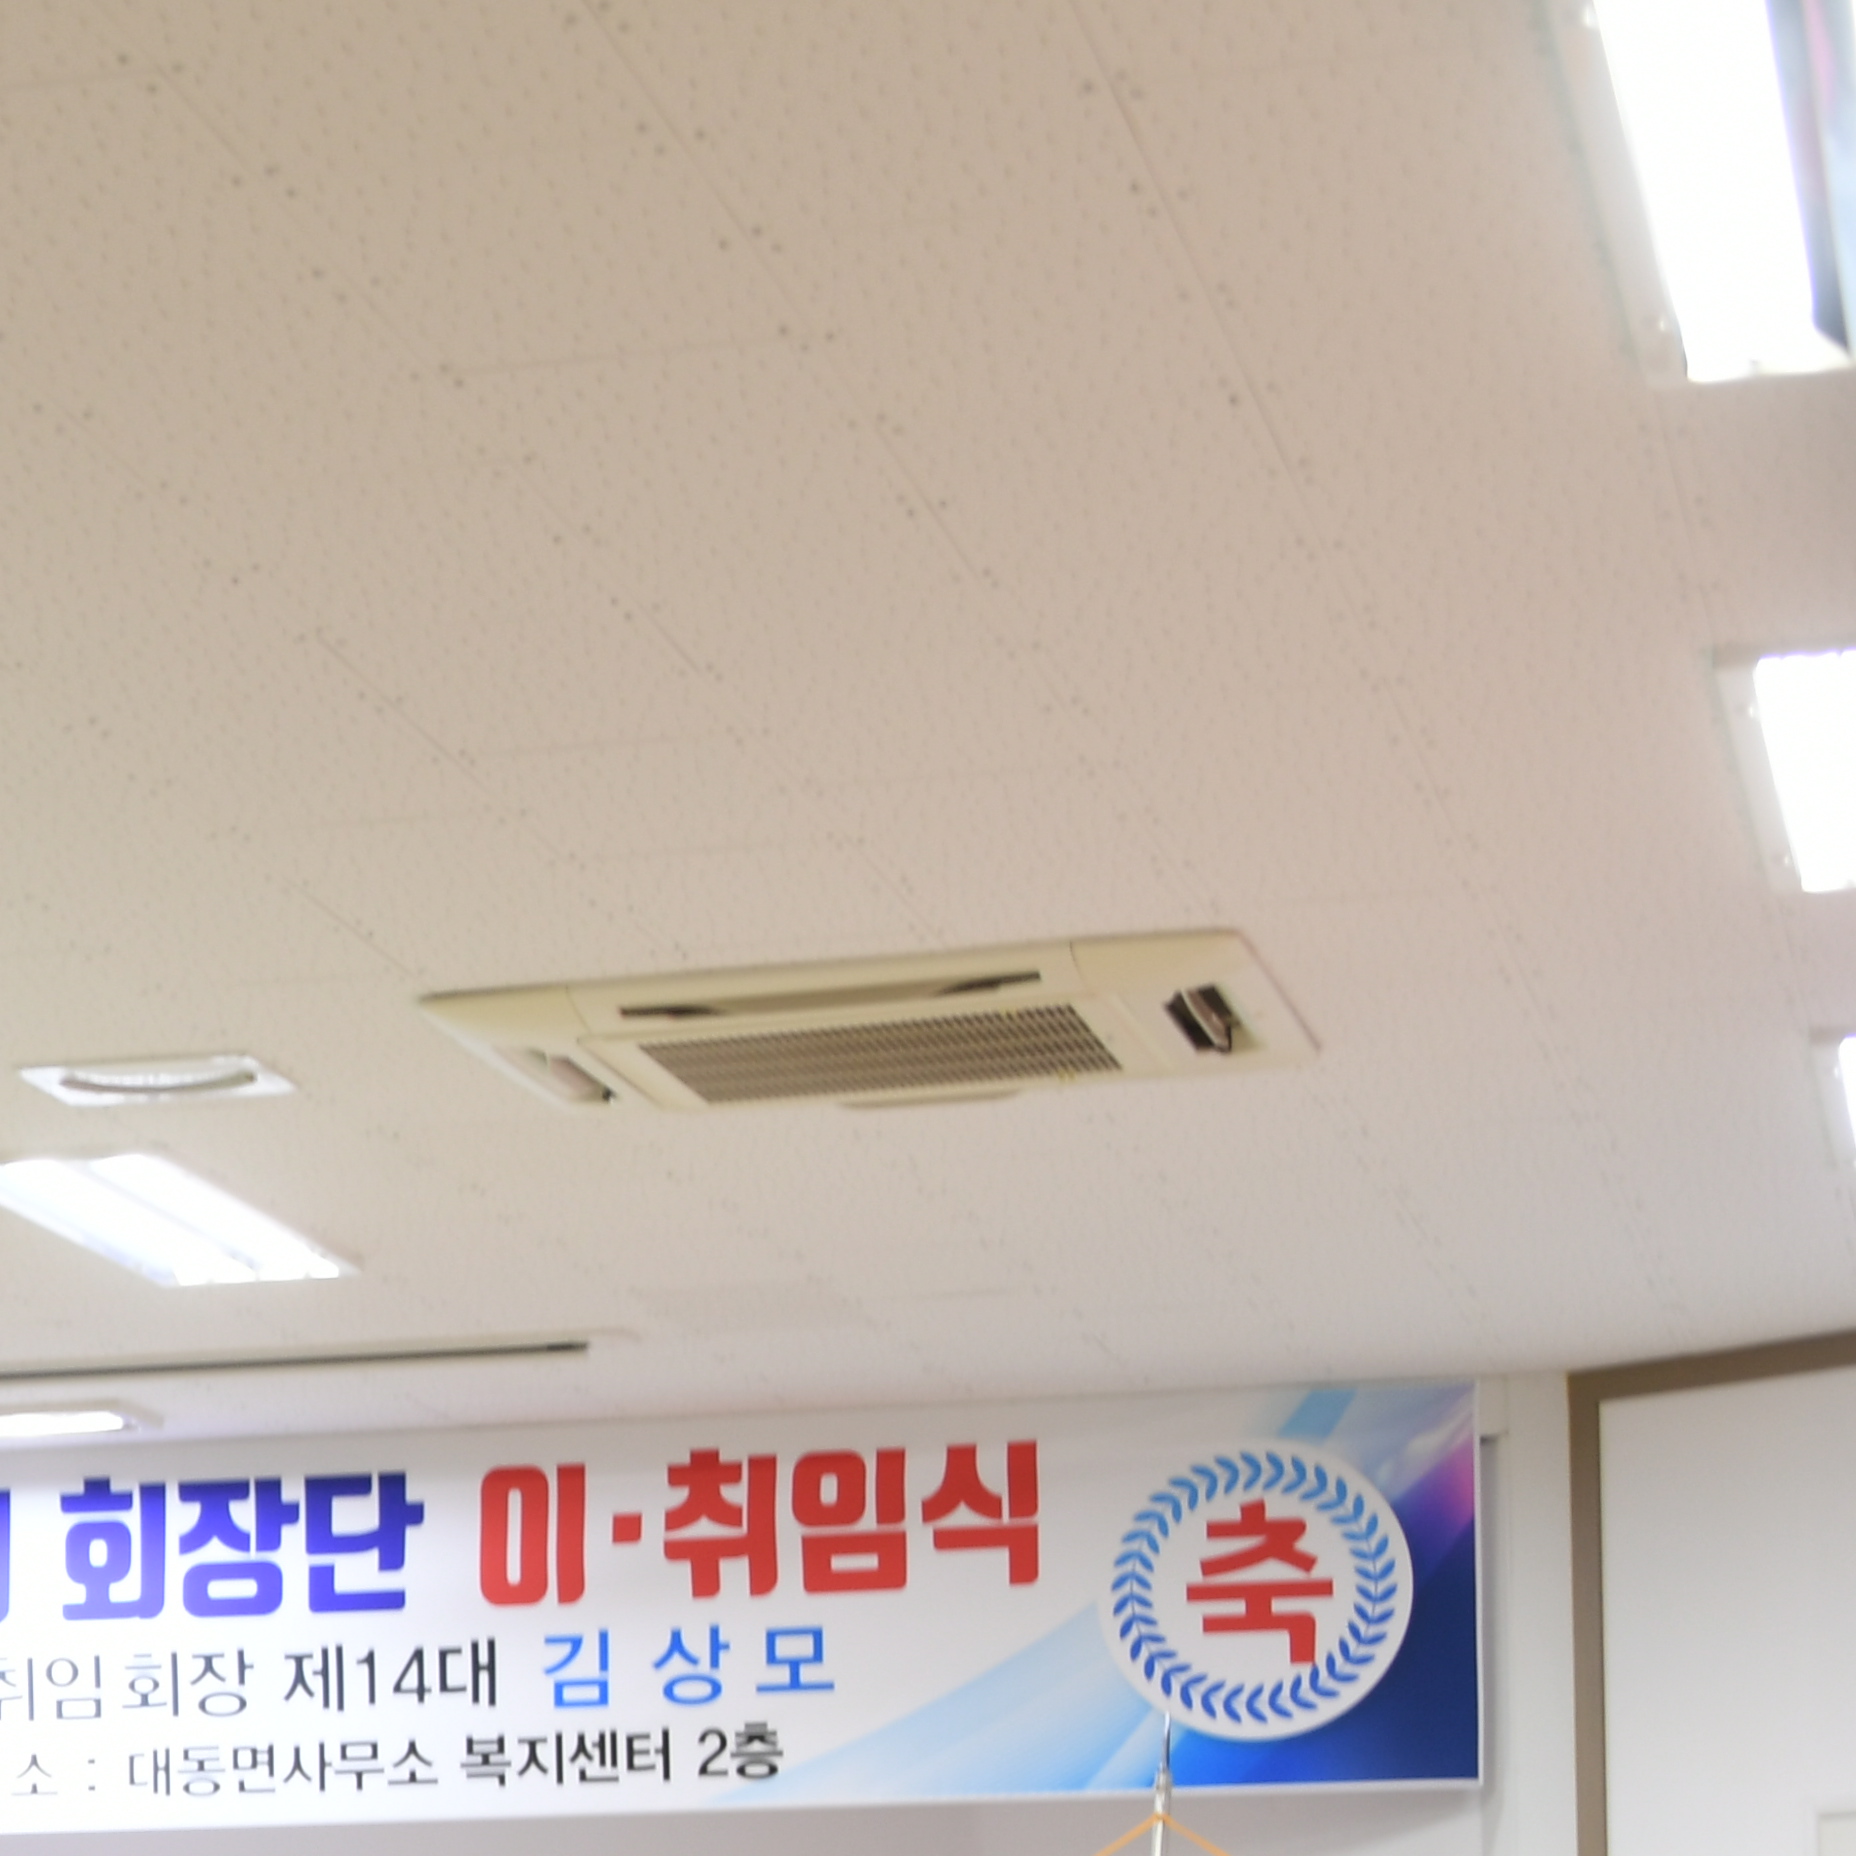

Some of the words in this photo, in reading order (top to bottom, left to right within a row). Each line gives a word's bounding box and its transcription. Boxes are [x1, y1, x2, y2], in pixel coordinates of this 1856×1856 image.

[60, 1471, 426, 1619] 회장단
[478, 1440, 1039, 1605] 이·취임식
[1185, 1497, 1335, 1665] 축
[285, 1638, 496, 1711] 제14대
[129, 1739, 438, 1795] 대동면사무소
[462, 1728, 670, 1786] 복지센터
[699, 1722, 783, 1780] 2층
